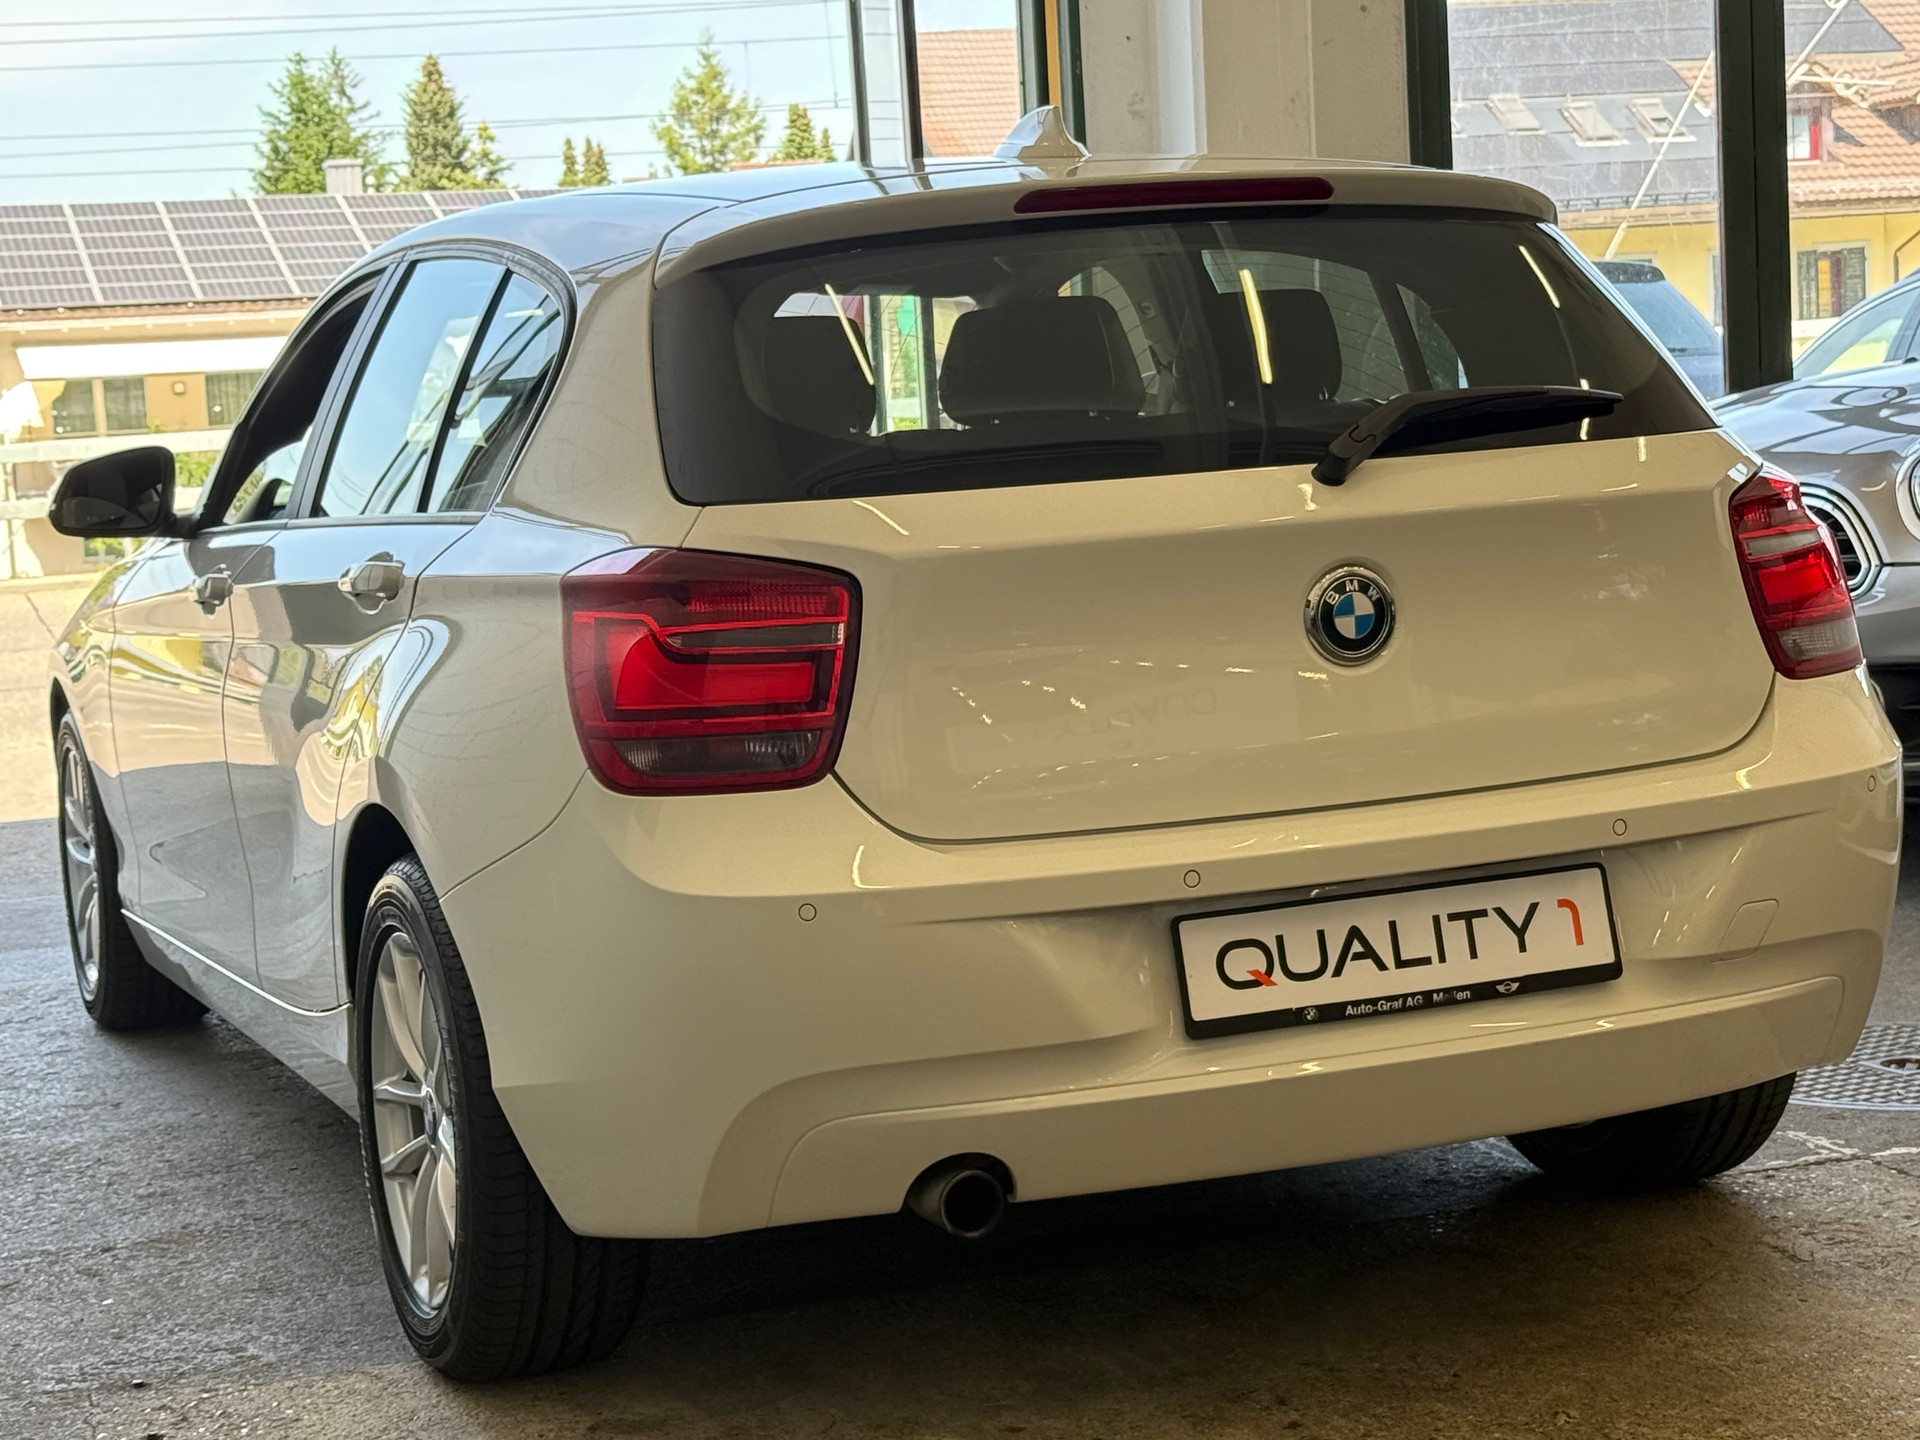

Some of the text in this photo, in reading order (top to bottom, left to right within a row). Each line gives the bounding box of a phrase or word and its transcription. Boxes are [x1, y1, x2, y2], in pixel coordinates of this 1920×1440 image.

[1325, 580, 1380, 605] BMW
[1215, 898, 1584, 990] QUALITY 1
[1345, 990, 1471, 1016] Auto-Graf AG Mlen
